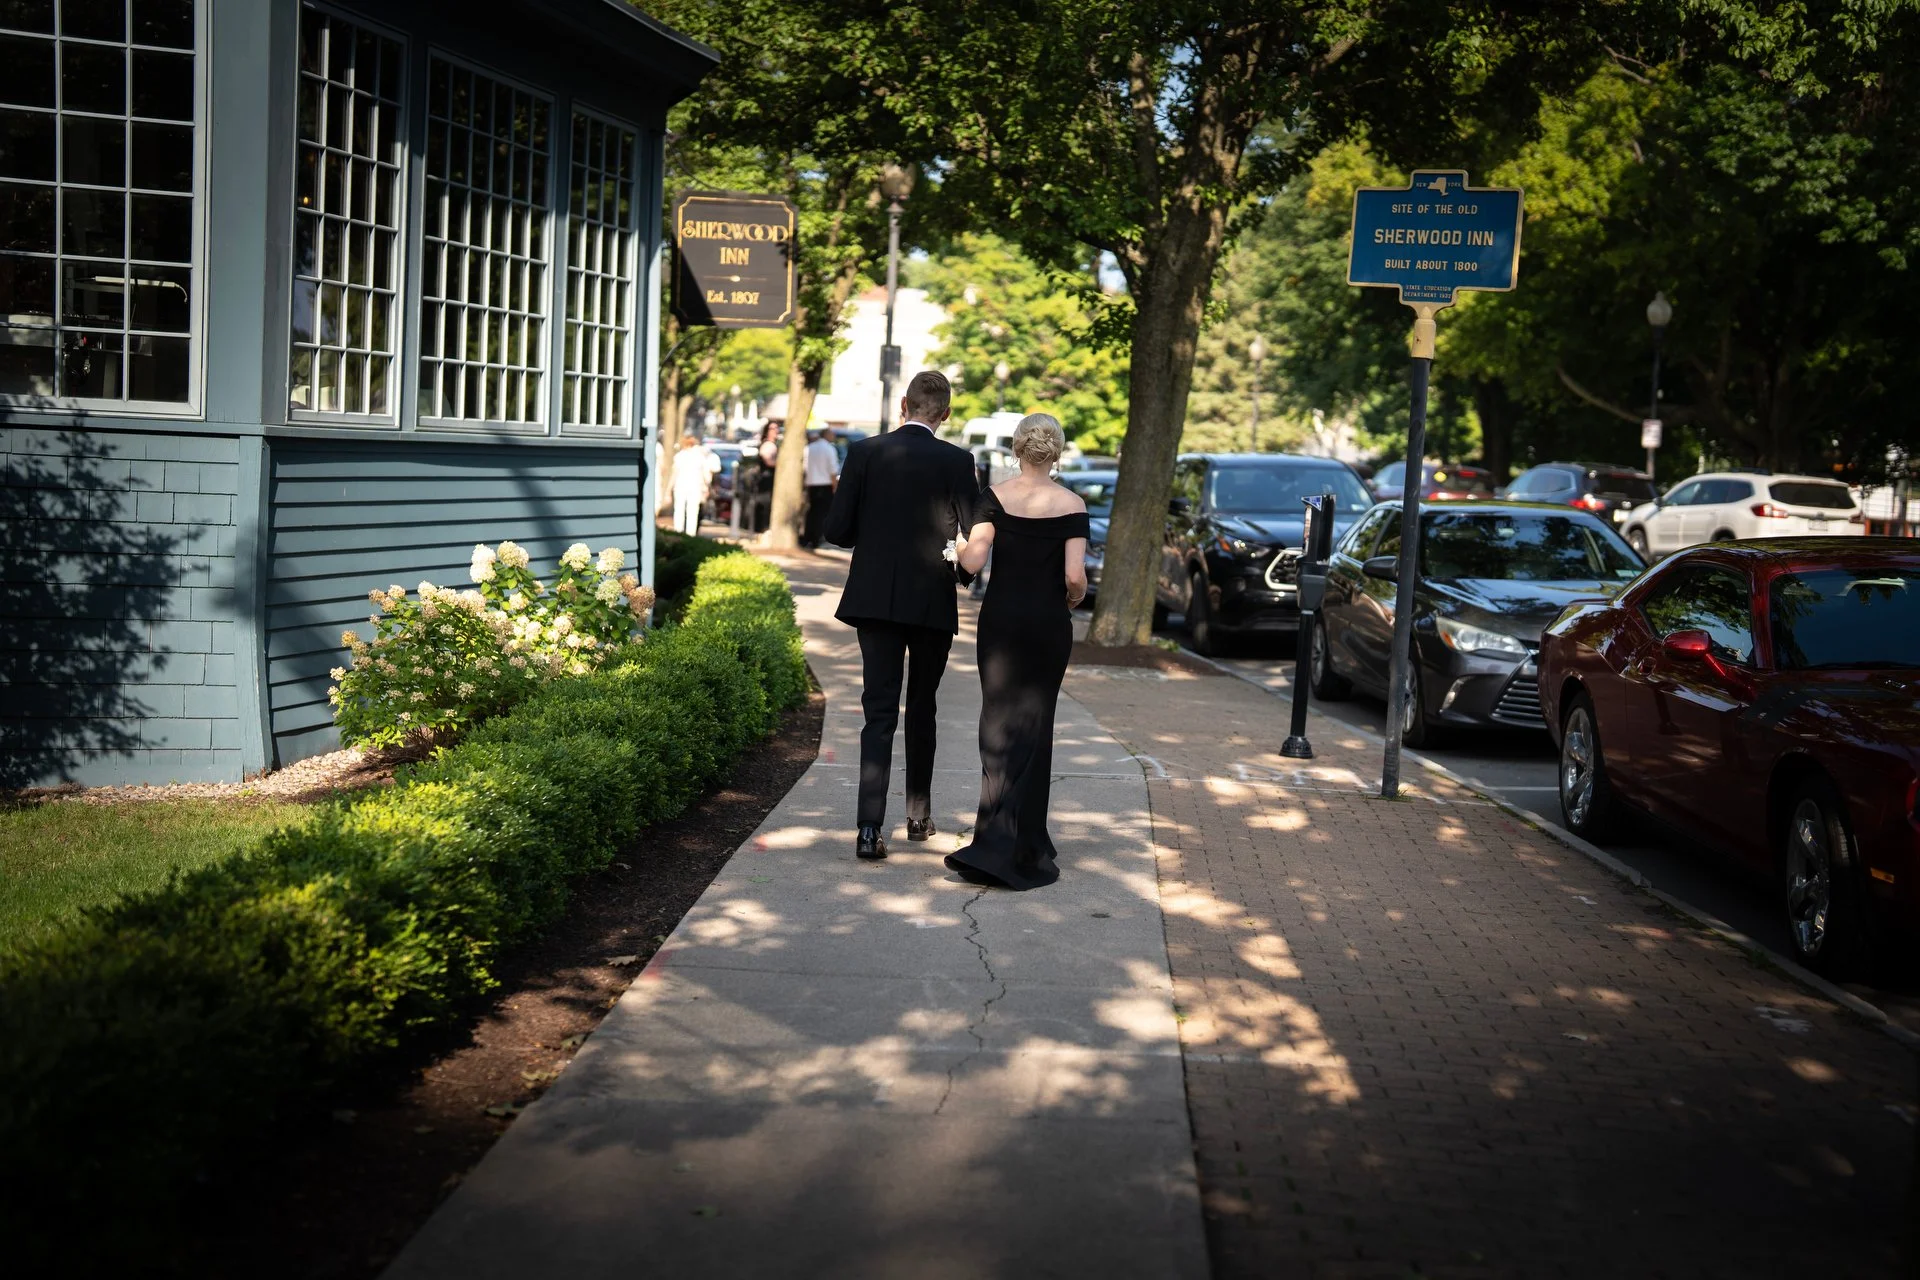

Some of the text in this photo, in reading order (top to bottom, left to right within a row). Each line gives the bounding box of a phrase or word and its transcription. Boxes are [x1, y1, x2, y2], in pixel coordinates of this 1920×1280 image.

[1391, 203, 1478, 215] SITE OF THE OLD
[681, 219, 789, 242] SHERWOOD
[1374, 228, 1494, 247] SHERWOOD INN
[720, 247, 750, 265] INN
[1384, 258, 1478, 272] BUILT ABOUT 1800
[706, 289, 760, 305] Est. 1807
